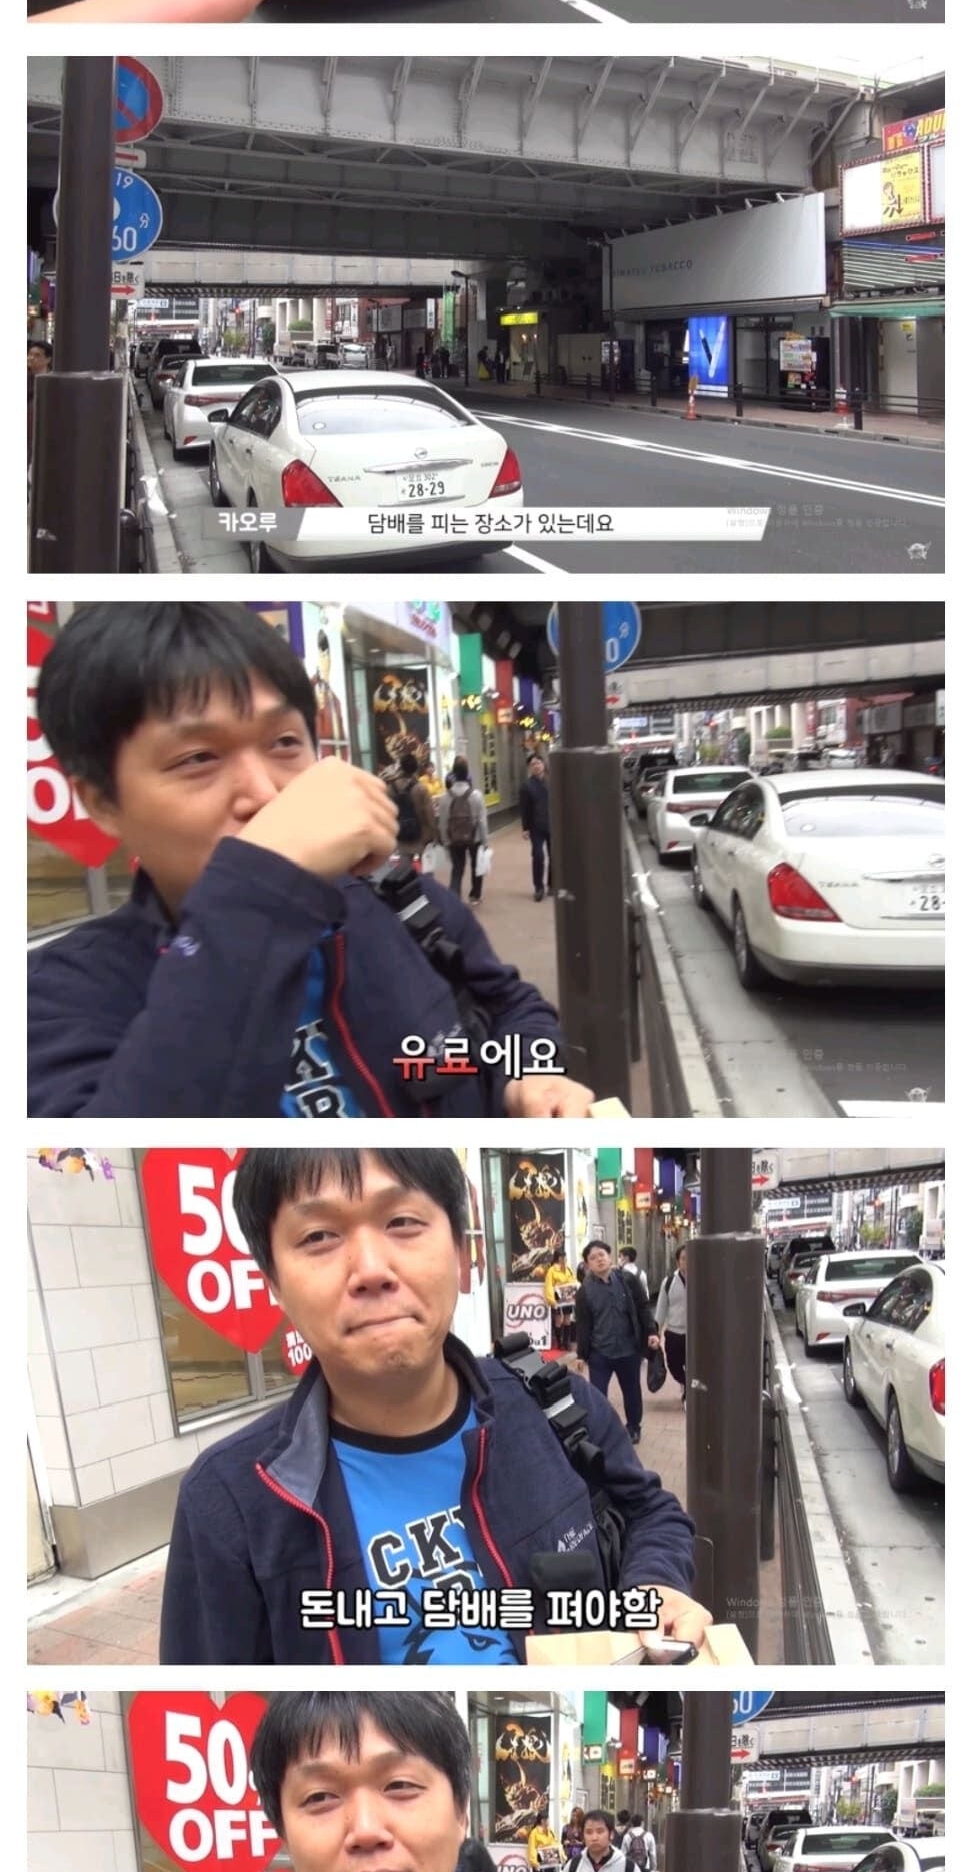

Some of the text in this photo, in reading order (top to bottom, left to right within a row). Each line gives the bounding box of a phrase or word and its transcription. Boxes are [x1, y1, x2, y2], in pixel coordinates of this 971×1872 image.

[187, 1259, 279, 1314] OF
[506, 1304, 546, 1321] UNO
[287, 1343, 312, 1367] 100
[169, 1808, 278, 1862] OFF
